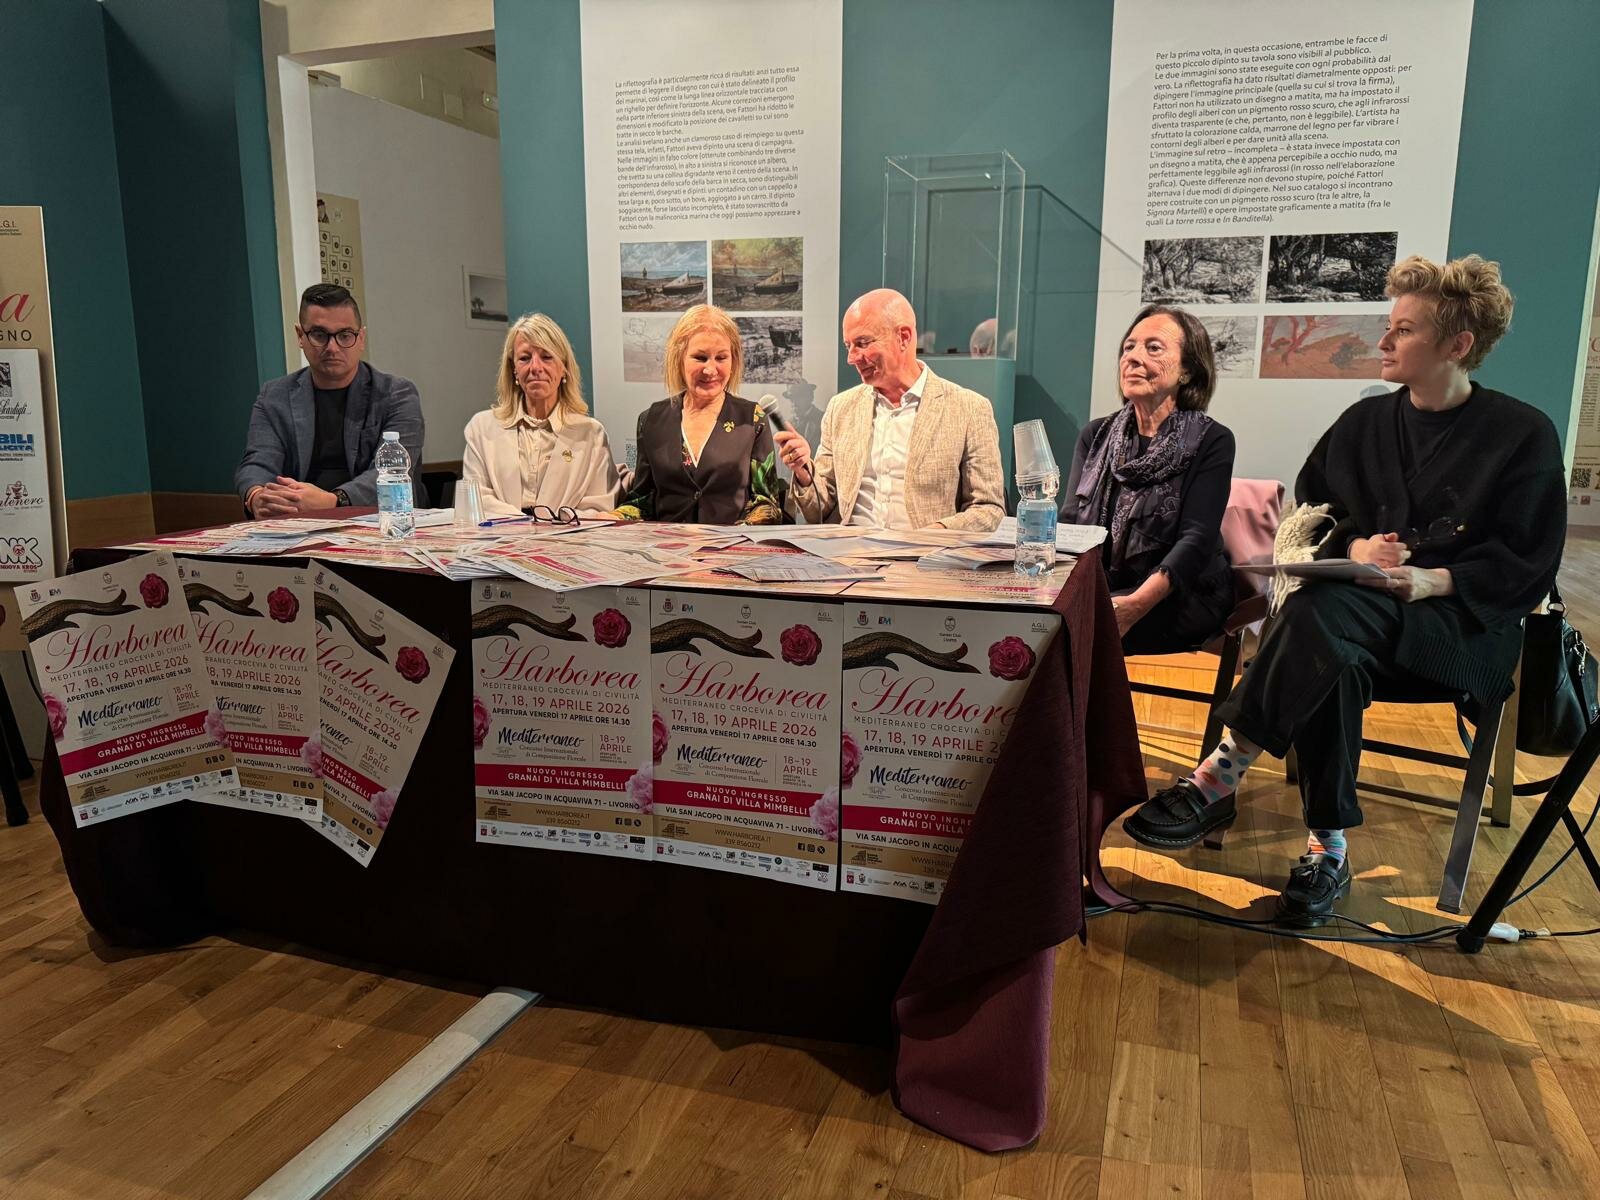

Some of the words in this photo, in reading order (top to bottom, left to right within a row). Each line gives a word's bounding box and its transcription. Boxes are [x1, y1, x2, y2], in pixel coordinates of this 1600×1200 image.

[1156, 51, 1168, 59] Per
[1178, 49, 1200, 59] prima
[1202, 47, 1222, 57] volta,
[1233, 44, 1259, 55] questa
[1262, 40, 1303, 52] occasione,
[1305, 37, 1344, 47] entrambe
[1346, 36, 1354, 44] le
[1355, 34, 1378, 43] facce
[1155, 60, 1181, 70] questo
[1183, 58, 1210, 68] piccolo
[1212, 56, 1239, 66] dipinto
[1251, 53, 1275, 61] tavola
[1298, 50, 1323, 58] visibili
[1334, 46, 1371, 57] pubblico.
[1181, 68, 1216, 79] immagini
[1239, 65, 1258, 73] state
[1260, 62, 1294, 73] eseguite
[1312, 59, 1330, 69] ogni
[1332, 56, 1376, 68] probabilità
[1146, 218, 1163, 227] quali
[1232, 214, 1273, 222] Banditella).
[45, 624, 188, 673] Harborea
[480, 637, 641, 690] Harborea
[63, 681, 81, 696] 17,
[85, 676, 103, 691] 18,
[107, 672, 119, 684] 19
[124, 662, 161, 679] APRILE
[165, 655, 189, 669] 2026
[222, 668, 232, 678] 19
[236, 670, 270, 682] APRILE
[275, 674, 300, 685] 2026
[659, 653, 830, 710] Harborea
[492, 694, 507, 705] 17,
[512, 696, 528, 707] 18,
[533, 697, 545, 707] 19
[550, 699, 592, 711] APRILE
[599, 703, 630, 714] 2026
[852, 668, 1018, 724] Harbore
[78, 696, 163, 728] Mediterraneo
[278, 703, 298, 712] 18-19
[278, 712, 304, 721] APRILE
[492, 708, 527, 716] APERTURA
[530, 710, 558, 719] VENERDÌ
[570, 714, 593, 722] APRILE
[662, 697, 726, 709] MEDITERRANEO
[730, 705, 773, 715] CROCEVIA
[791, 710, 827, 721] CIVILITÀ
[374, 720, 401, 741] 2026
[672, 710, 687, 722] 17,
[693, 712, 709, 724] 18,
[714, 715, 726, 725] 19
[732, 717, 777, 731] APRILE
[783, 723, 817, 736] 2026
[854, 716, 926, 729] MEDITERRANEO
[931, 724, 980, 734] CROCEVIA
[98, 742, 133, 758] GRANAI
[136, 739, 145, 748] DI
[148, 733, 169, 745] VILLA
[172, 725, 204, 739] MIMBELLI
[498, 727, 585, 748] Mediterraneo
[600, 735, 625, 743] 18-19
[672, 725, 708, 735] APERTURA
[710, 728, 740, 738] VENERDÌ
[752, 734, 777, 743] APRILE
[797, 739, 817, 747] 14.30
[864, 731, 882, 744] 17,
[888, 733, 906, 746] 18,
[912, 735, 926, 747] 19
[932, 737, 983, 752] APRILE
[244, 742, 263, 751] VILLA
[265, 745, 298, 755] MIMBELLI
[600, 744, 632, 753] APRILE
[677, 744, 768, 768] Mediterraneo
[784, 755, 811, 766] 18-19
[784, 766, 818, 776] APRILE
[508, 773, 540, 782] GRANAI
[556, 777, 579, 786] VILLA
[583, 779, 623, 790] MIMBELLI
[527, 767, 556, 775] NUOVO
[560, 770, 603, 779] INGRESSO
[870, 765, 973, 790] Mediterraneo
[337, 772, 370, 798] MIMBELLI
[706, 786, 736, 796] NUOVO
[741, 791, 786, 803] INGRESSO
[352, 802, 377, 821] LIVORNO
[687, 790, 721, 802] GRANAI
[724, 796, 733, 804] DI
[736, 798, 761, 808] VILLA
[764, 802, 807, 815] MIMBELLI
[666, 806, 677, 814] VIA
[679, 808, 692, 817] SAN
[695, 810, 722, 821] JACOPO
[734, 816, 774, 828] ACQUAVIVA
[792, 824, 824, 835] LIVORNO
[880, 816, 918, 828] GRANAI
[922, 822, 931, 830] DI
[936, 823, 964, 834] VILLA
[903, 811, 937, 821] NUOVO
